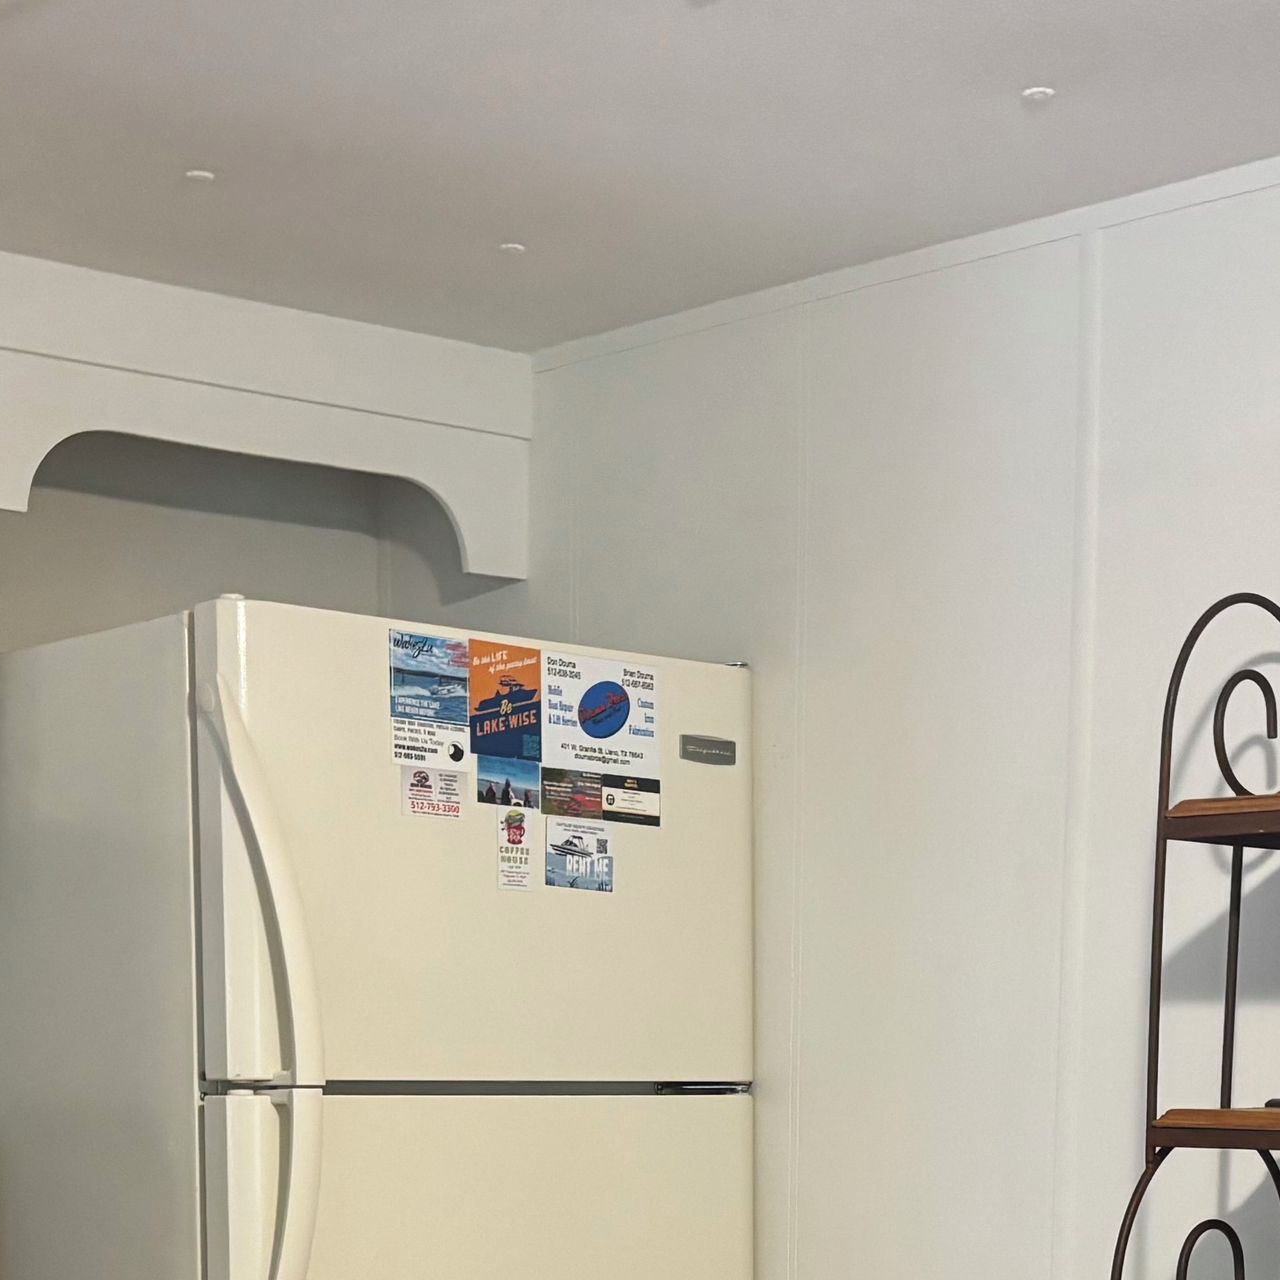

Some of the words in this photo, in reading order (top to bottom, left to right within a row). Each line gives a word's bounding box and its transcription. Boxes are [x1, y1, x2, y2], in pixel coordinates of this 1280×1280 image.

[491, 650, 508, 662] LIFE
[547, 656, 557, 665] Don
[500, 699, 512, 715] Be
[476, 717, 506, 736] LAKE
[508, 710, 537, 728] WISE
[411, 801, 460, 814] 512-793-3300
[500, 846, 530, 856] COFFEE
[566, 856, 591, 877] RENT
